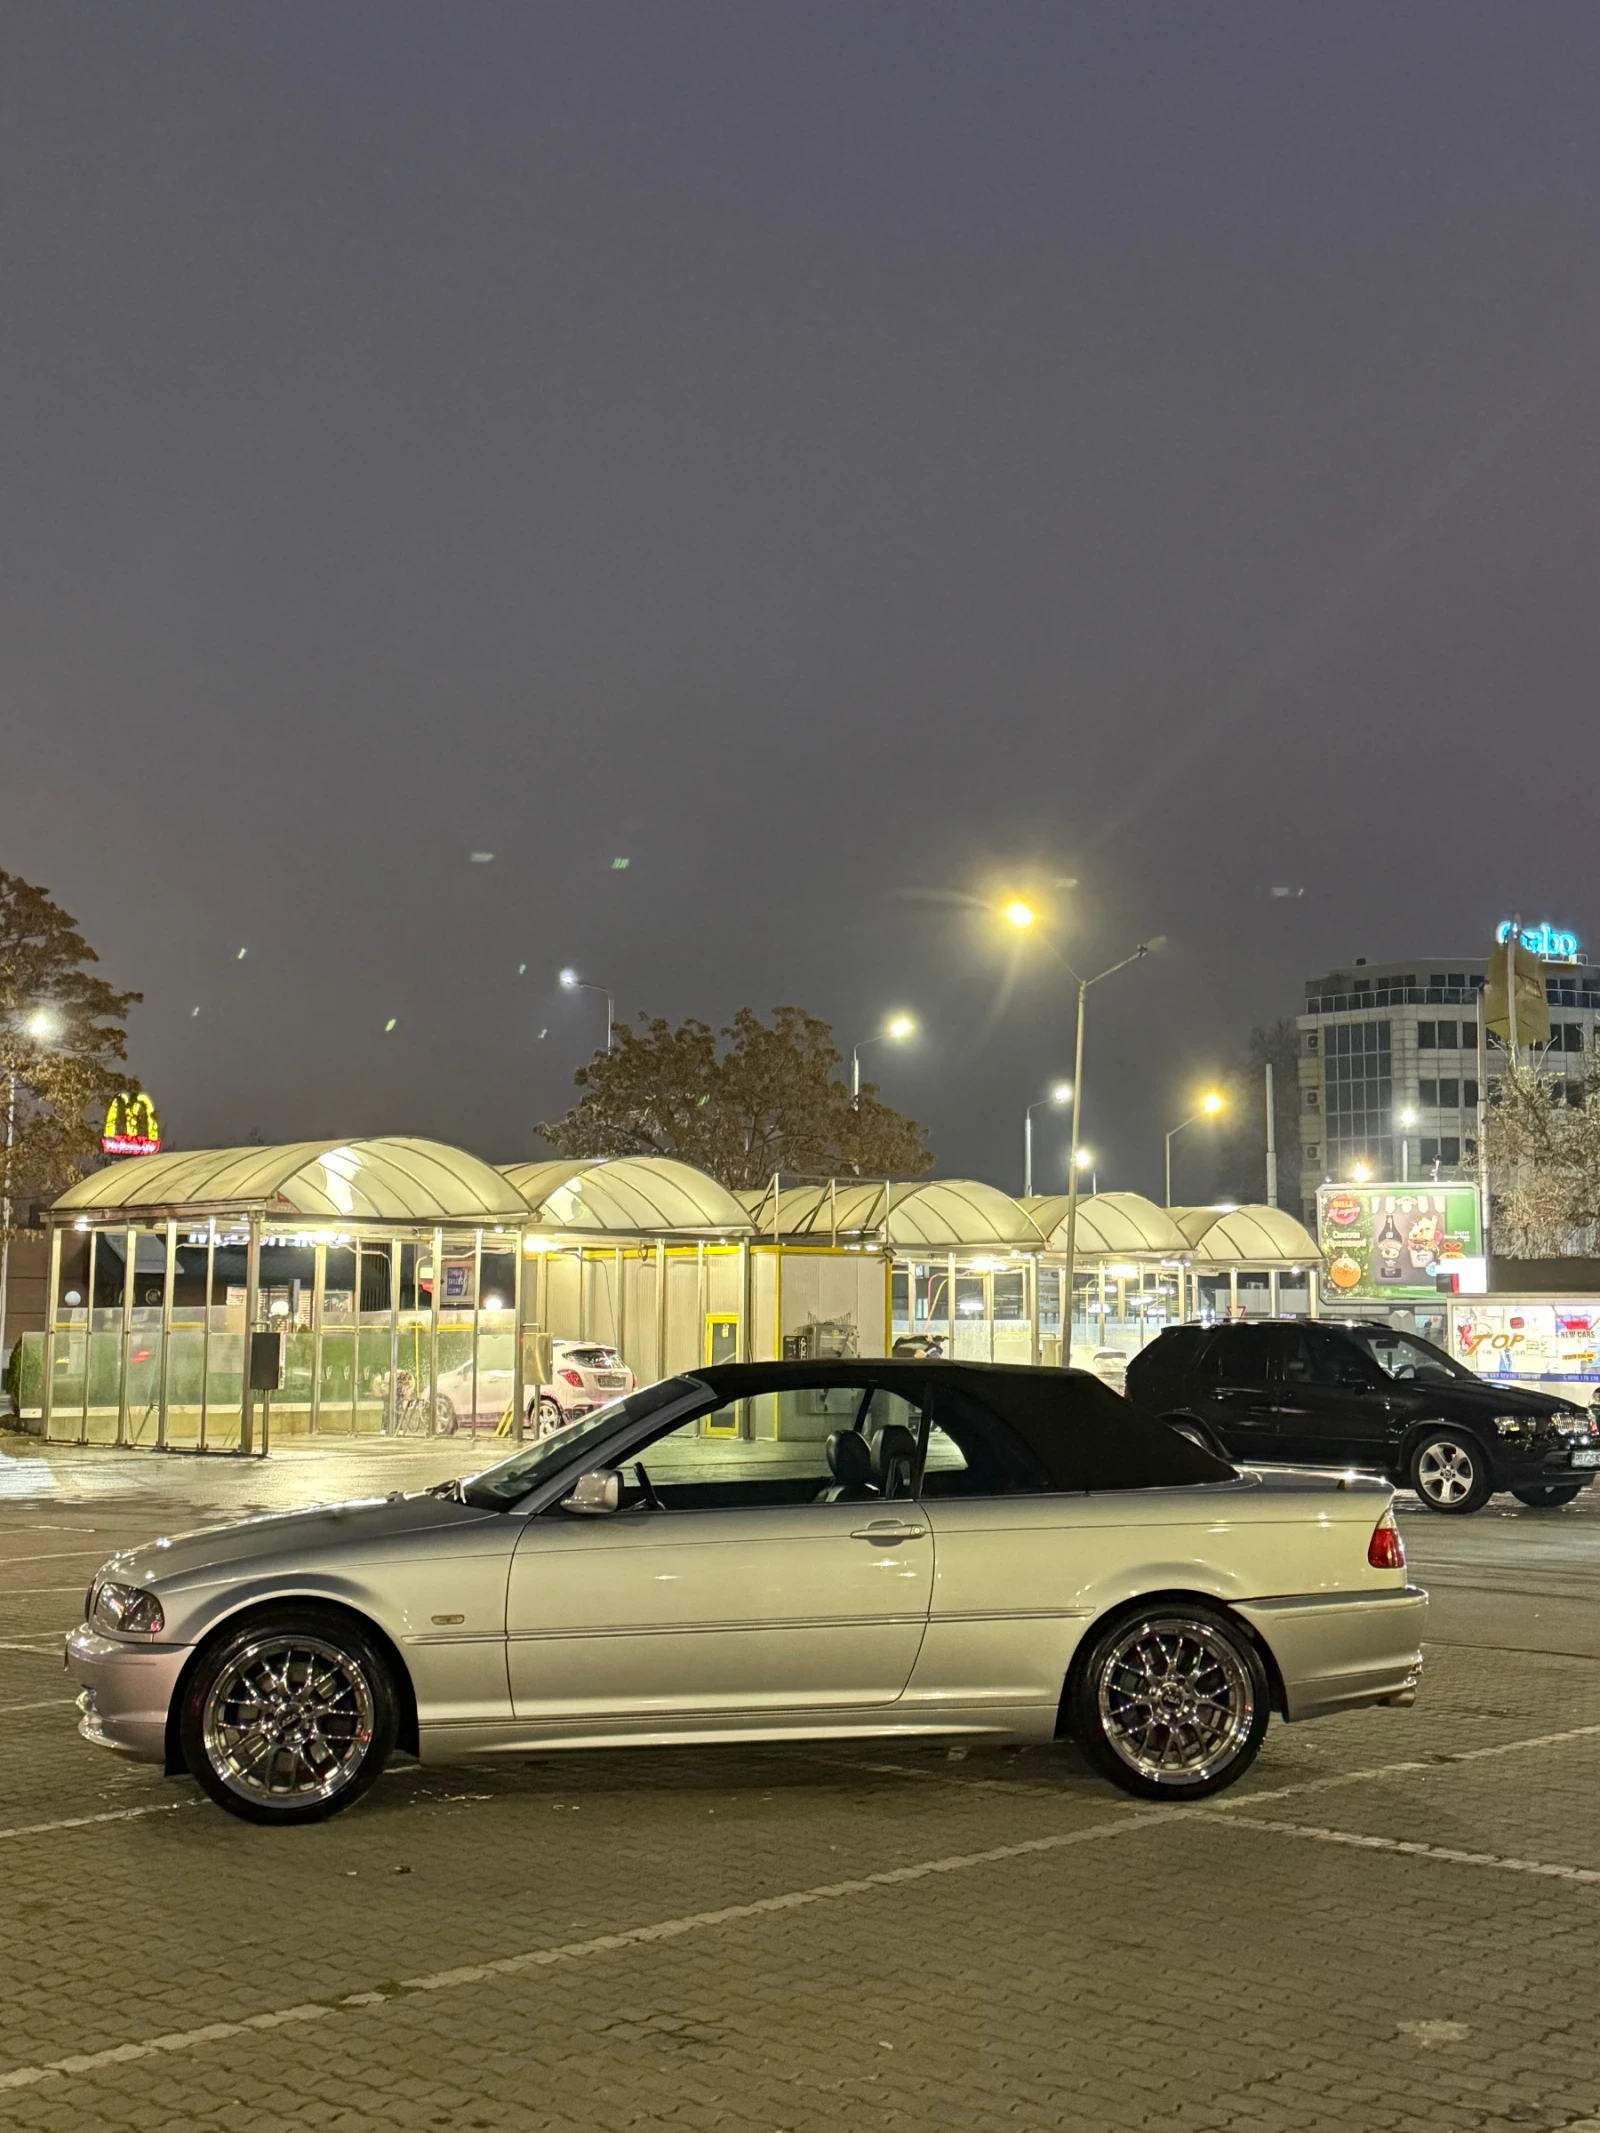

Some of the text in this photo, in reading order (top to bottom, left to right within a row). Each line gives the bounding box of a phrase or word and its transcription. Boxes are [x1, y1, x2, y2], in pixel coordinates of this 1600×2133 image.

[1561, 1331, 1595, 1339] NEW CARS
[1466, 1333, 1525, 1356] TOP
